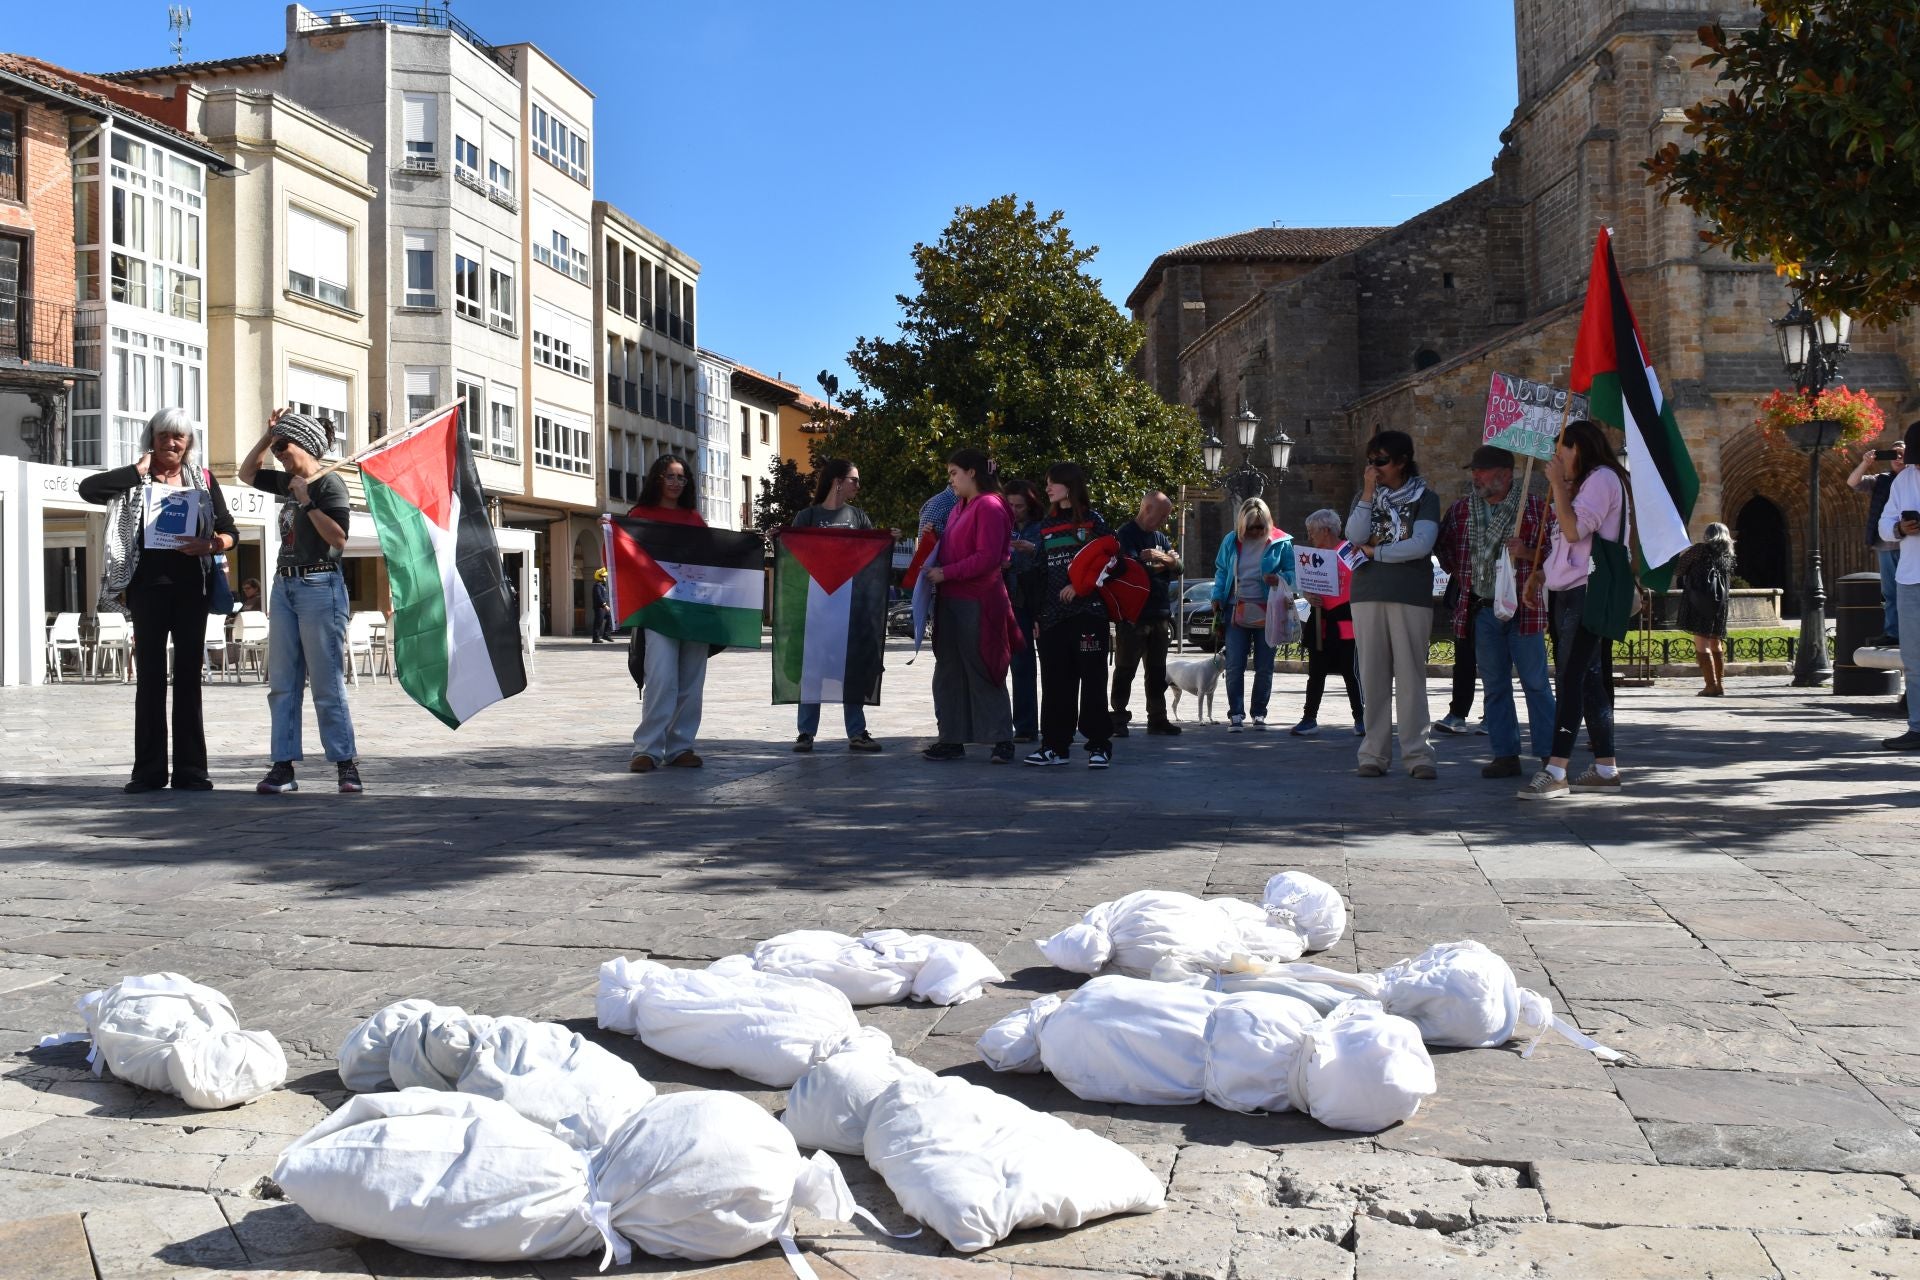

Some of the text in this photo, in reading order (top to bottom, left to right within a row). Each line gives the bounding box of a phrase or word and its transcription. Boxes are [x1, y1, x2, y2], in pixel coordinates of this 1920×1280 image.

[44, 476, 69, 491] café
[232, 492, 242, 511] el
[249, 494, 264, 512] 37
[1304, 568, 1328, 577] Carrefour
